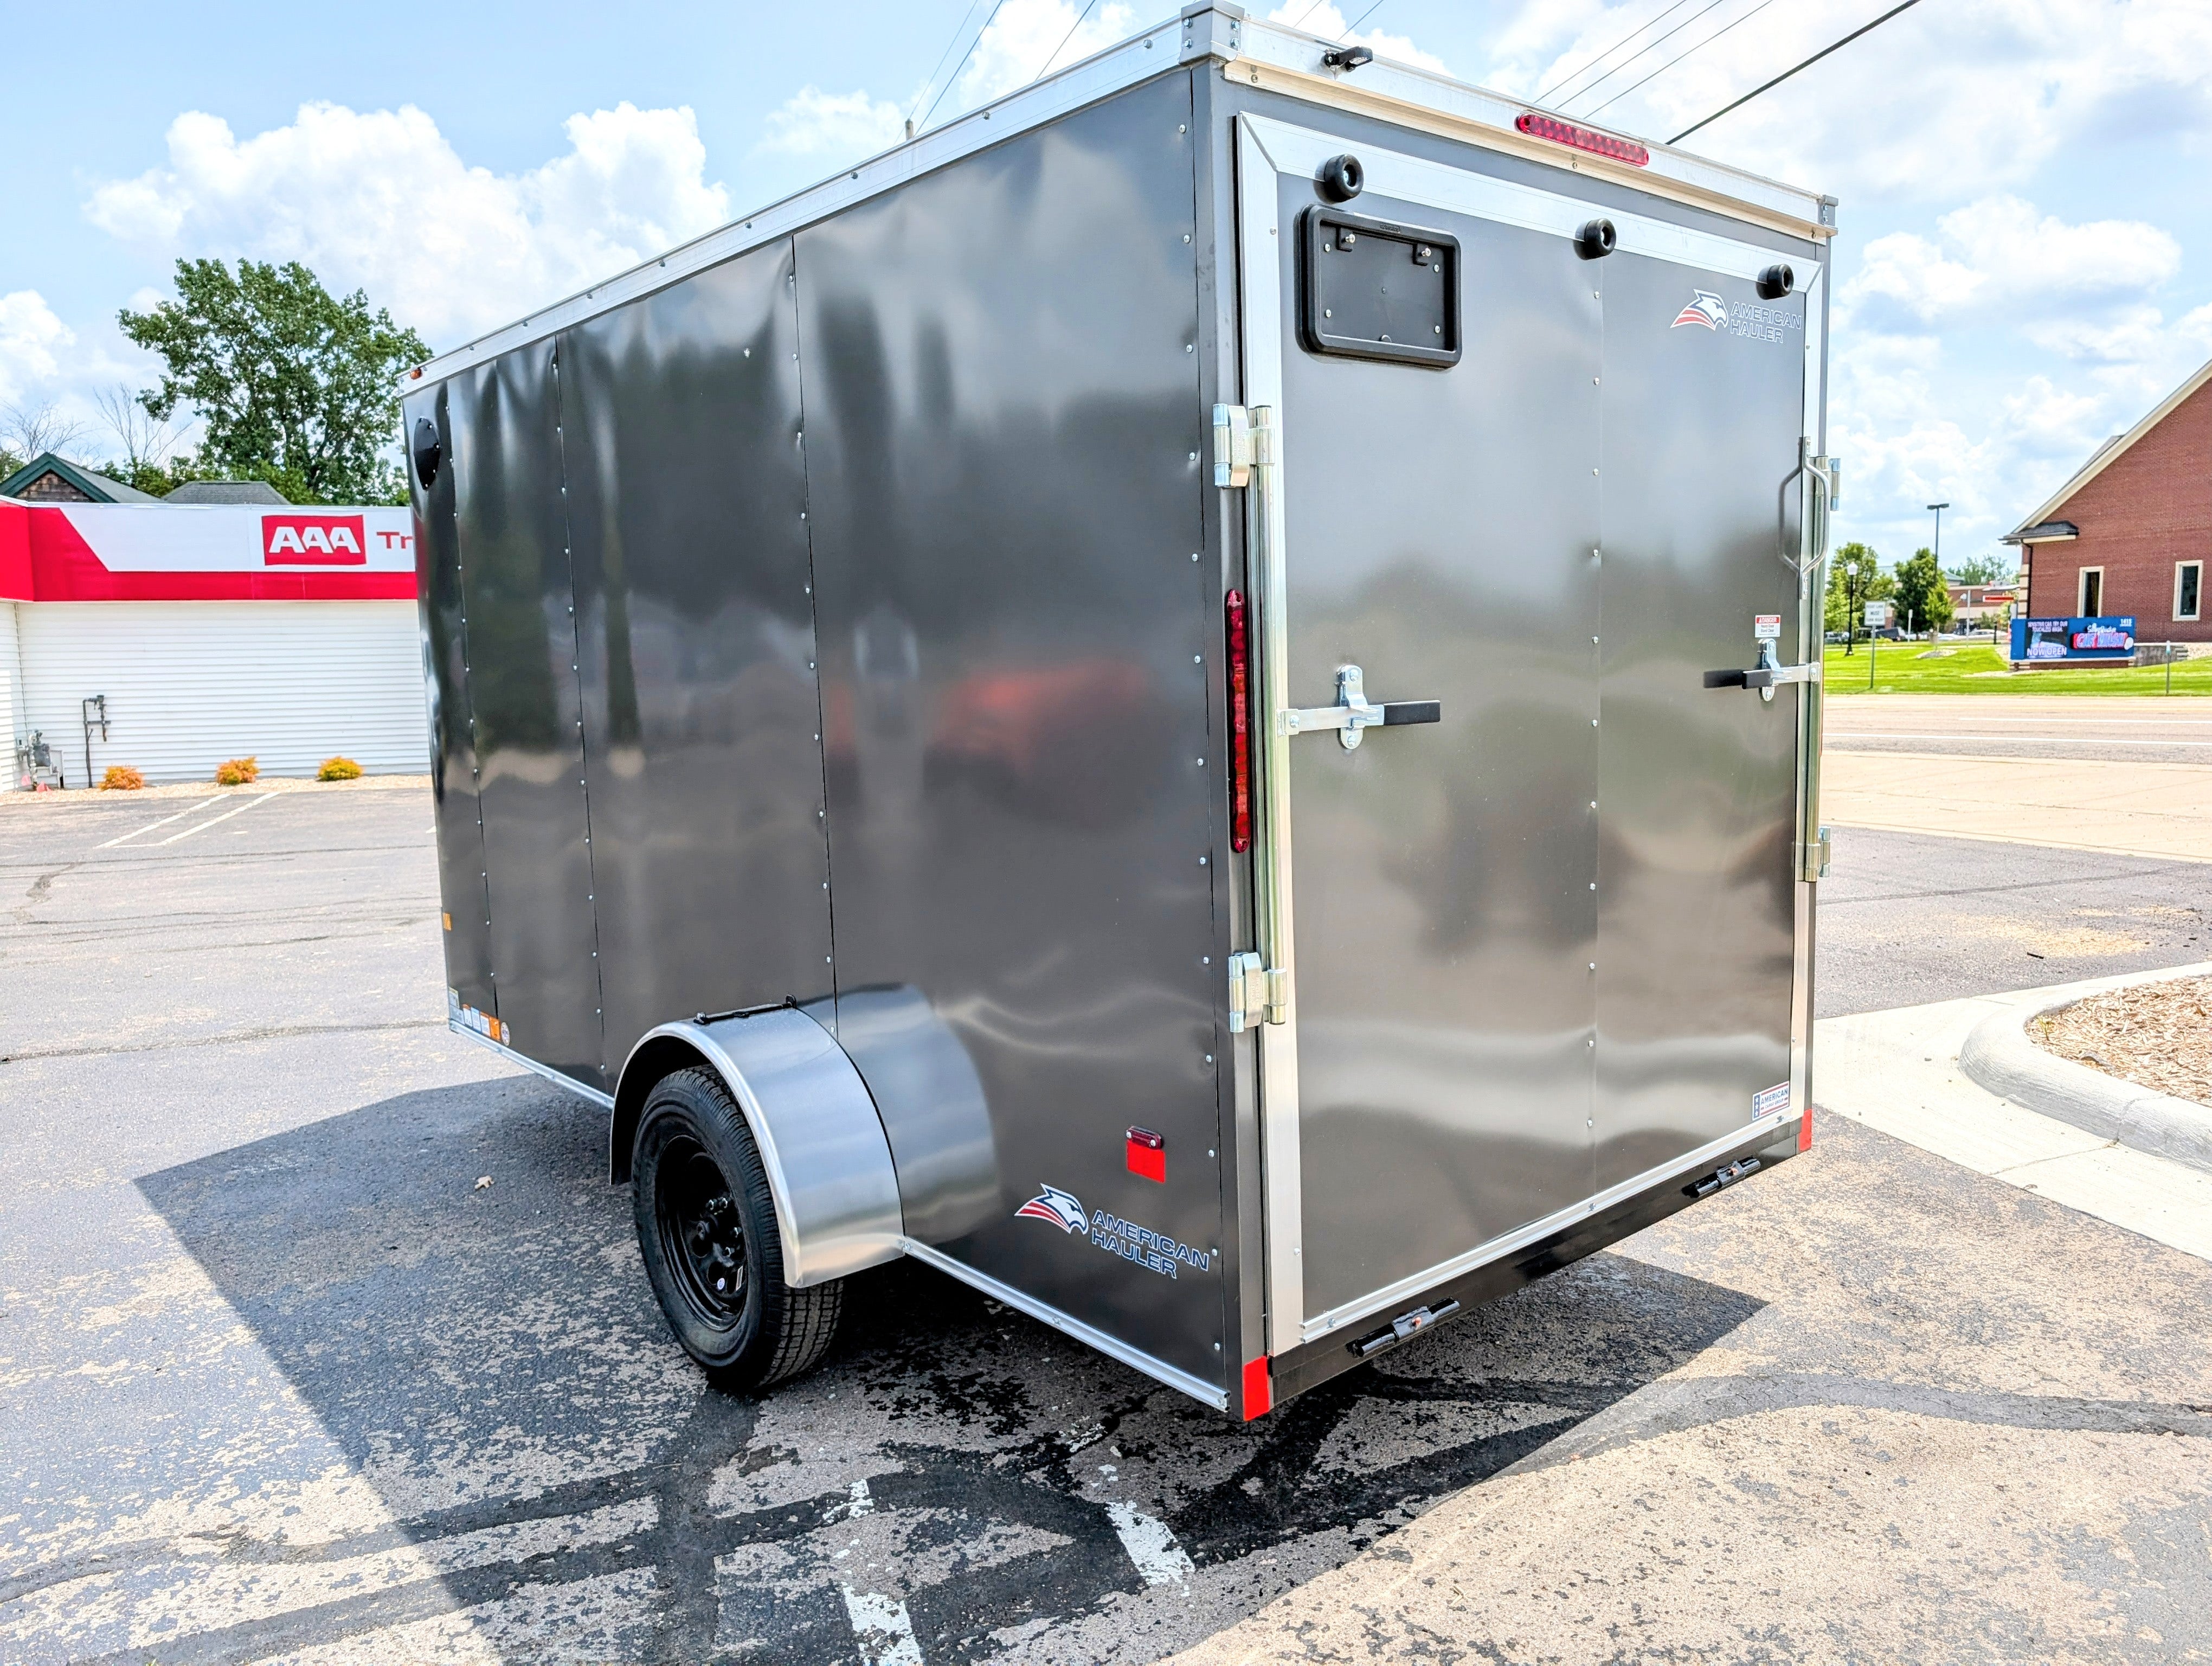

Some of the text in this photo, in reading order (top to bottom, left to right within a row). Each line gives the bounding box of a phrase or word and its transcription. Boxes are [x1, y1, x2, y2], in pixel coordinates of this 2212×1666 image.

[1730, 301, 1802, 329] AMERICAN
[1730, 319, 1783, 343] HAULER
[269, 526, 361, 554] AAA
[2027, 646, 2067, 656] NOW OPEN
[1761, 1088, 1788, 1104] AMERICAN
[1091, 1209, 1208, 1271] AMERICAN
[1092, 1227, 1177, 1279] HAULER
